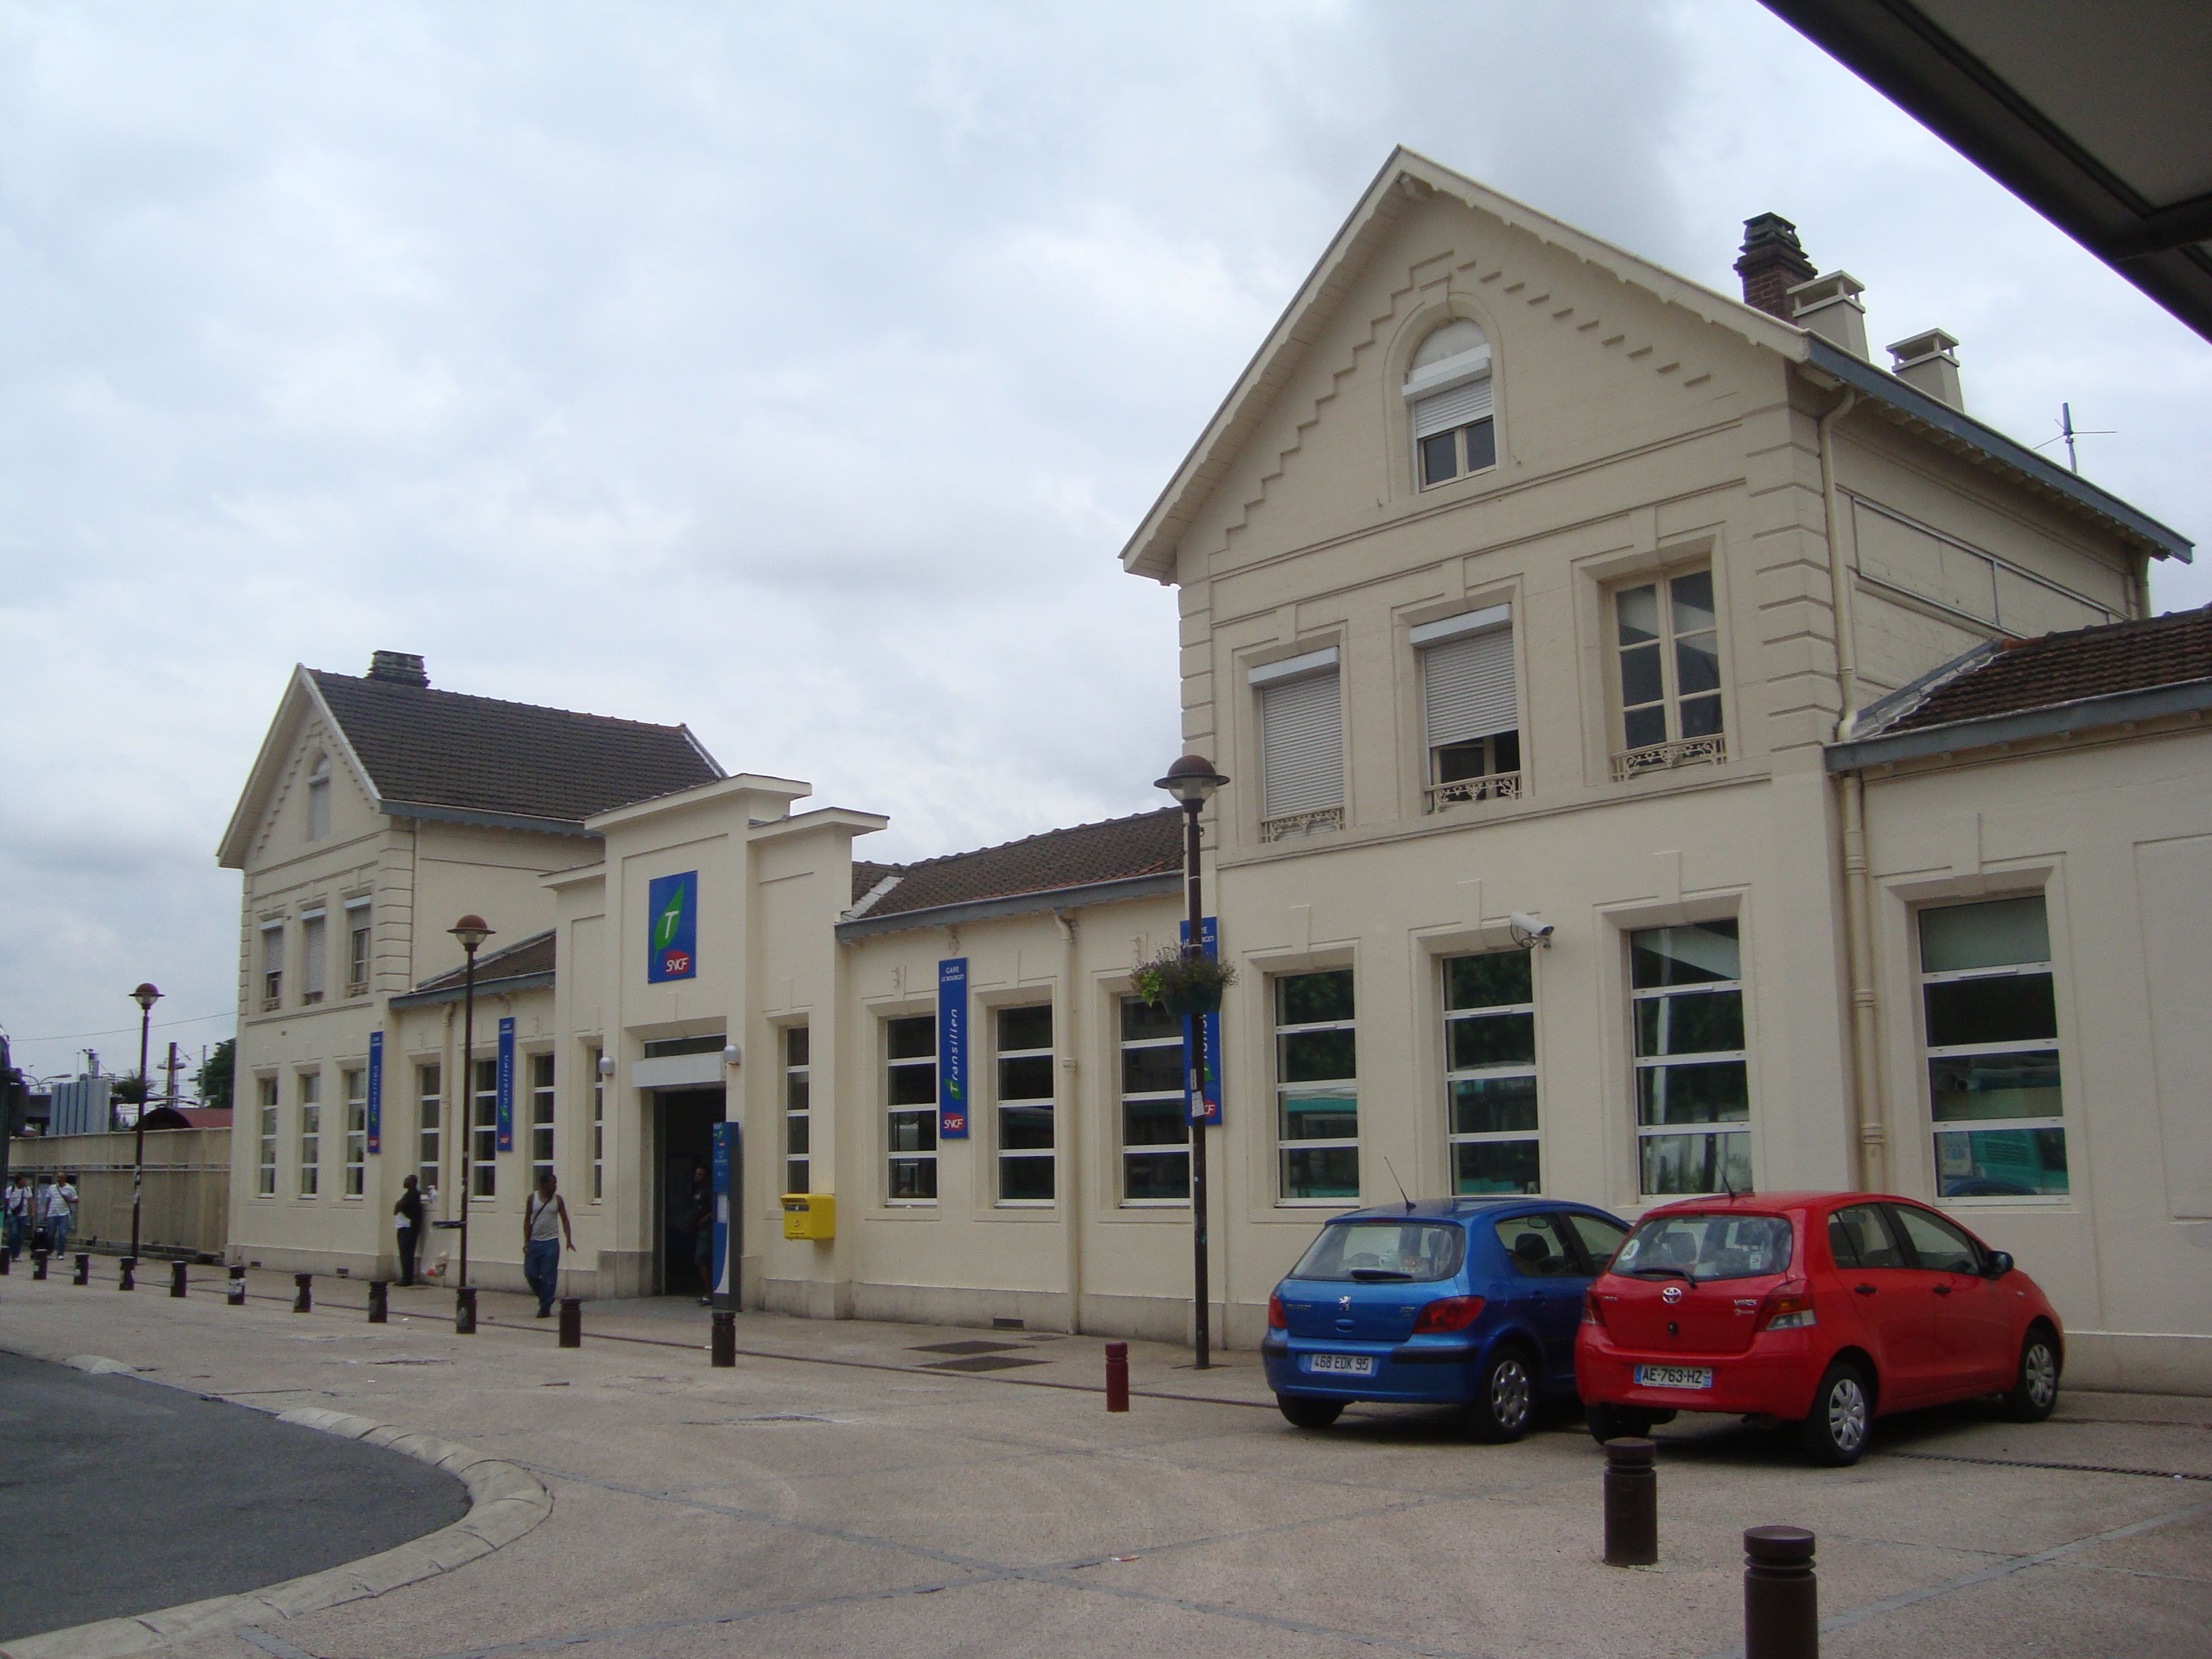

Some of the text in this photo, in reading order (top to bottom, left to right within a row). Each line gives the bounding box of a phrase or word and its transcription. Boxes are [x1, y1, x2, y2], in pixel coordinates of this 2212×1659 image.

[665, 910, 679, 939] T
[666, 957, 689, 972] SNCF
[949, 1008, 958, 1093] Transilien
[943, 1118, 963, 1128] SNCF
[1314, 1355, 1369, 1371] 468 EDK 95
[1642, 1368, 1703, 1384] AE-763-HZ
